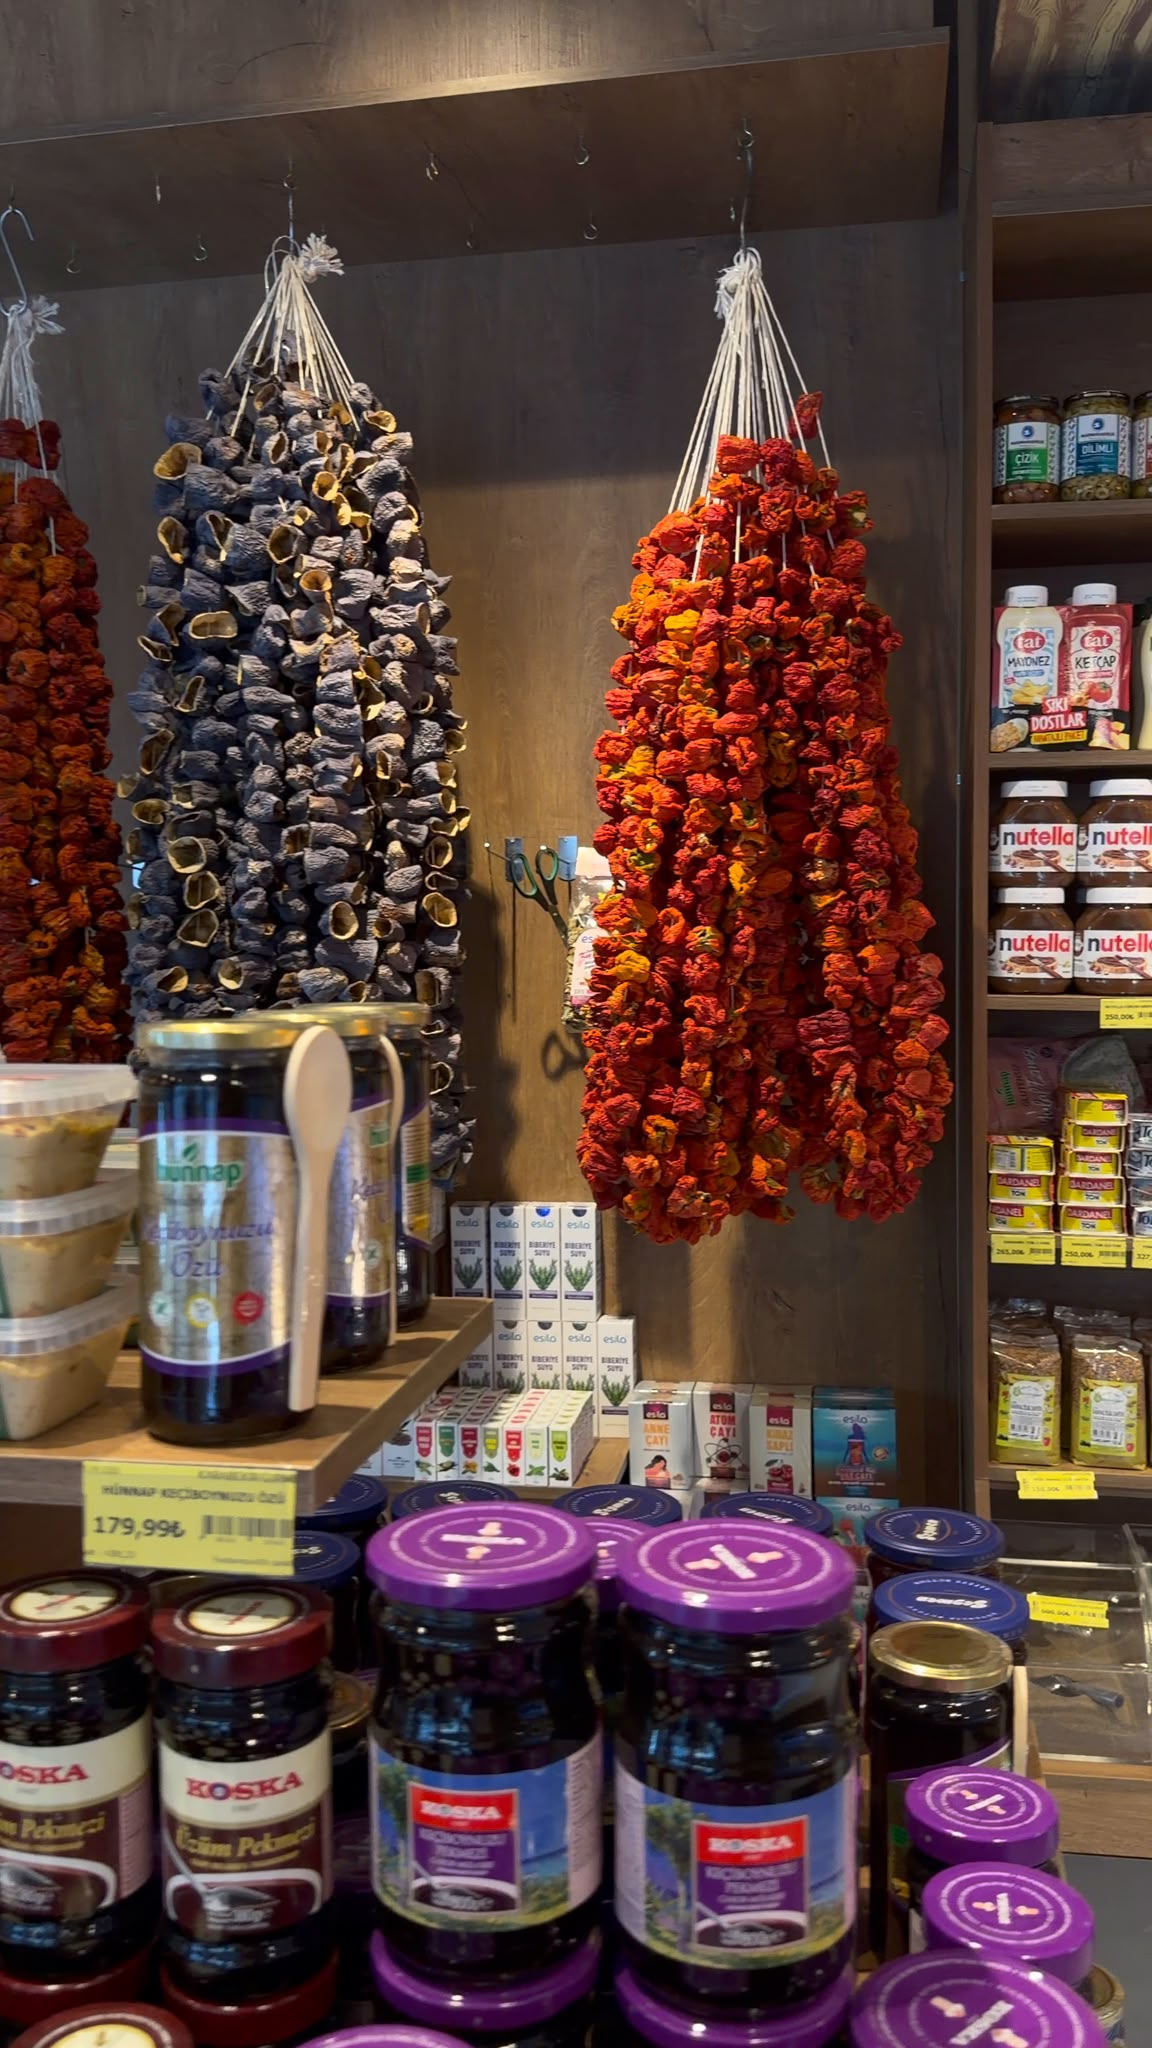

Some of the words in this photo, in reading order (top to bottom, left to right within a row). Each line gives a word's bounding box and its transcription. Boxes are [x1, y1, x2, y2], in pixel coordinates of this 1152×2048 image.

[1017, 633, 1042, 649] tat
[1085, 632, 1109, 648] tat
[1007, 655, 1051, 668] MAYONEZ
[1074, 655, 1117, 671] KETÇAP
[1030, 713, 1086, 731] DOSTLAR
[1003, 827, 1074, 846] nutella
[1093, 826, 1152, 845] nutell
[1000, 933, 1071, 953] nutella
[997, 1176, 1040, 1187] DARDANEL
[1069, 1179, 1114, 1190] DARDANEL
[1011, 1189, 1026, 1198] TON
[1084, 1193, 1100, 1201] TON
[495, 1220, 519, 1229] esila
[531, 1220, 554, 1229] esila
[567, 1221, 590, 1230] esila
[1081, 1222, 1097, 1230] TON
[498, 1332, 522, 1341] esila
[533, 1334, 557, 1343] esila
[568, 1333, 592, 1343] esila
[603, 1335, 627, 1344] esila
[709, 1413, 736, 1426] ATOM
[842, 1414, 868, 1424] esila
[643, 1423, 670, 1434] ANNE
[710, 1427, 737, 1440] ÇAYI
[645, 1435, 669, 1449] ÇAYI
[846, 1503, 871, 1512] esila
[94, 1515, 186, 1540] 179,99₺
[0, 1760, 89, 1786] OSKA
[186, 1771, 304, 1800] KOSKA
[420, 1800, 502, 1820] KOSKA
[708, 1835, 794, 1852] KOSKA
